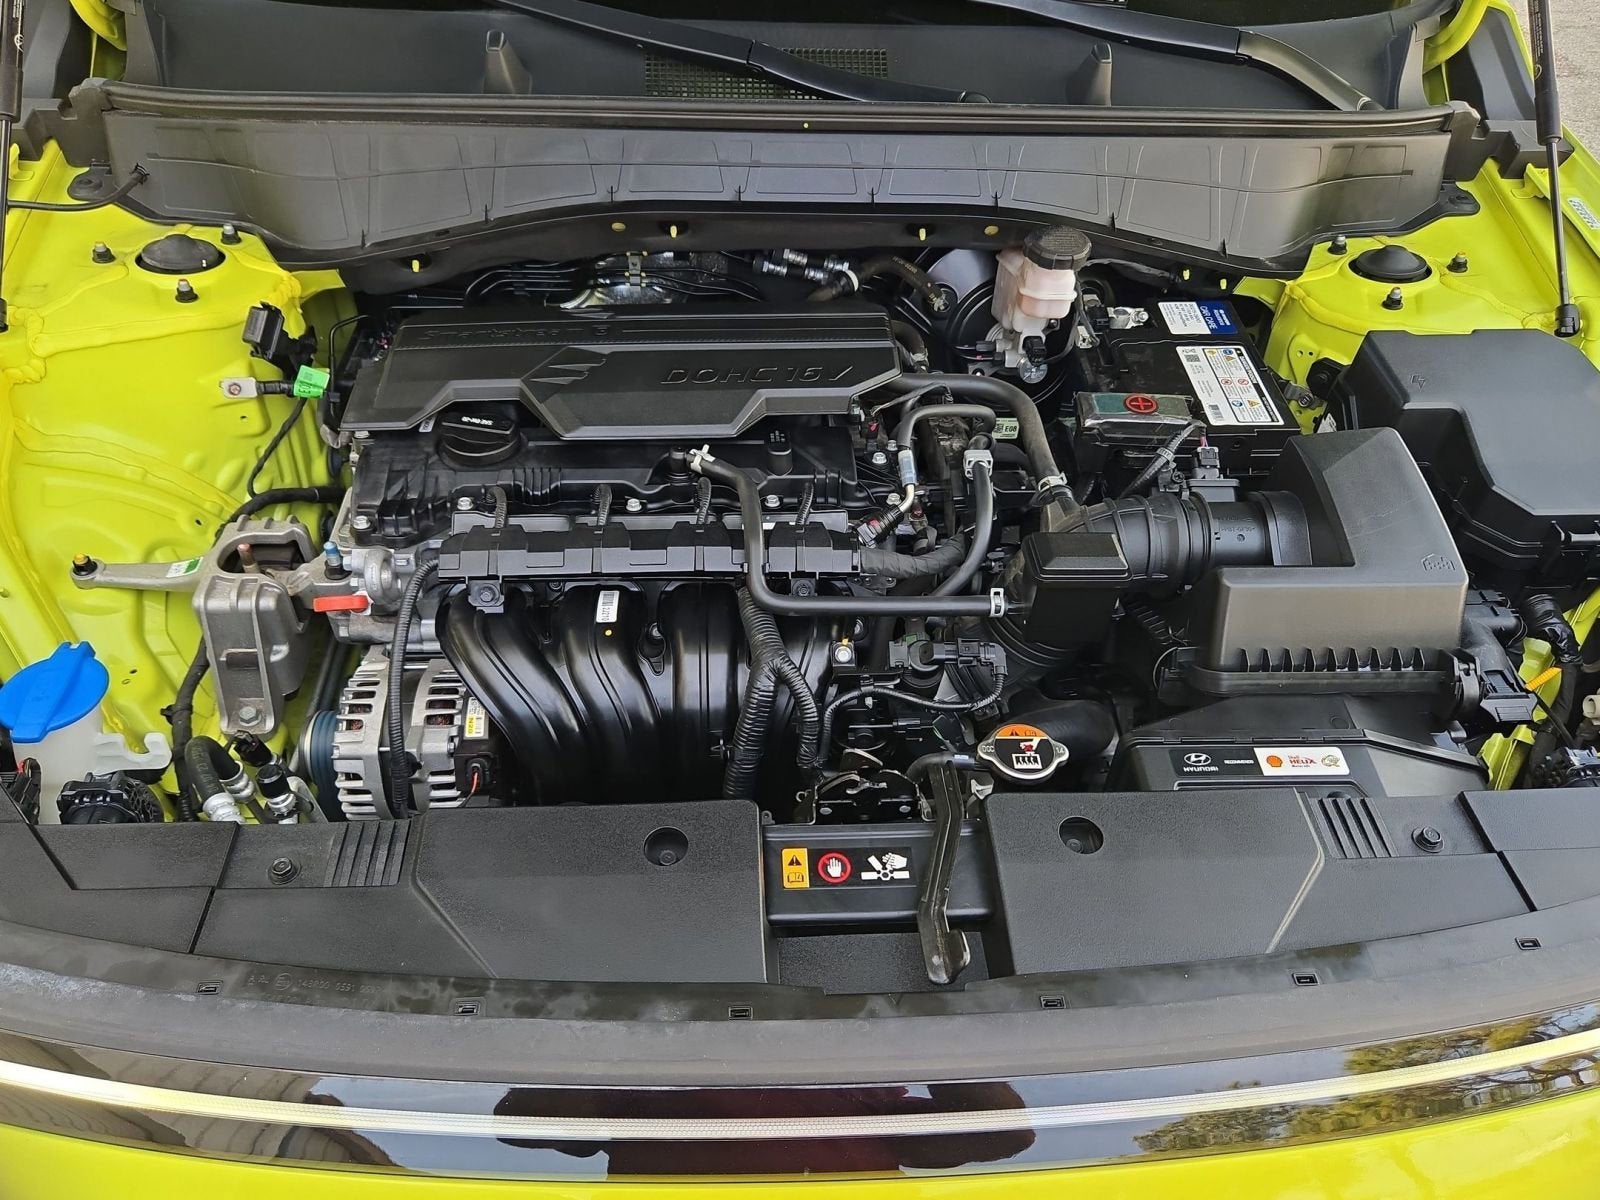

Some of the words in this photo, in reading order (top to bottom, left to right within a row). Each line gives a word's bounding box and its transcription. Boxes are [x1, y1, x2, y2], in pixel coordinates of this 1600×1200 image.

[1200, 305, 1211, 318] CAR
[1205, 316, 1218, 329] CARE
[660, 367, 778, 384] DOHC
